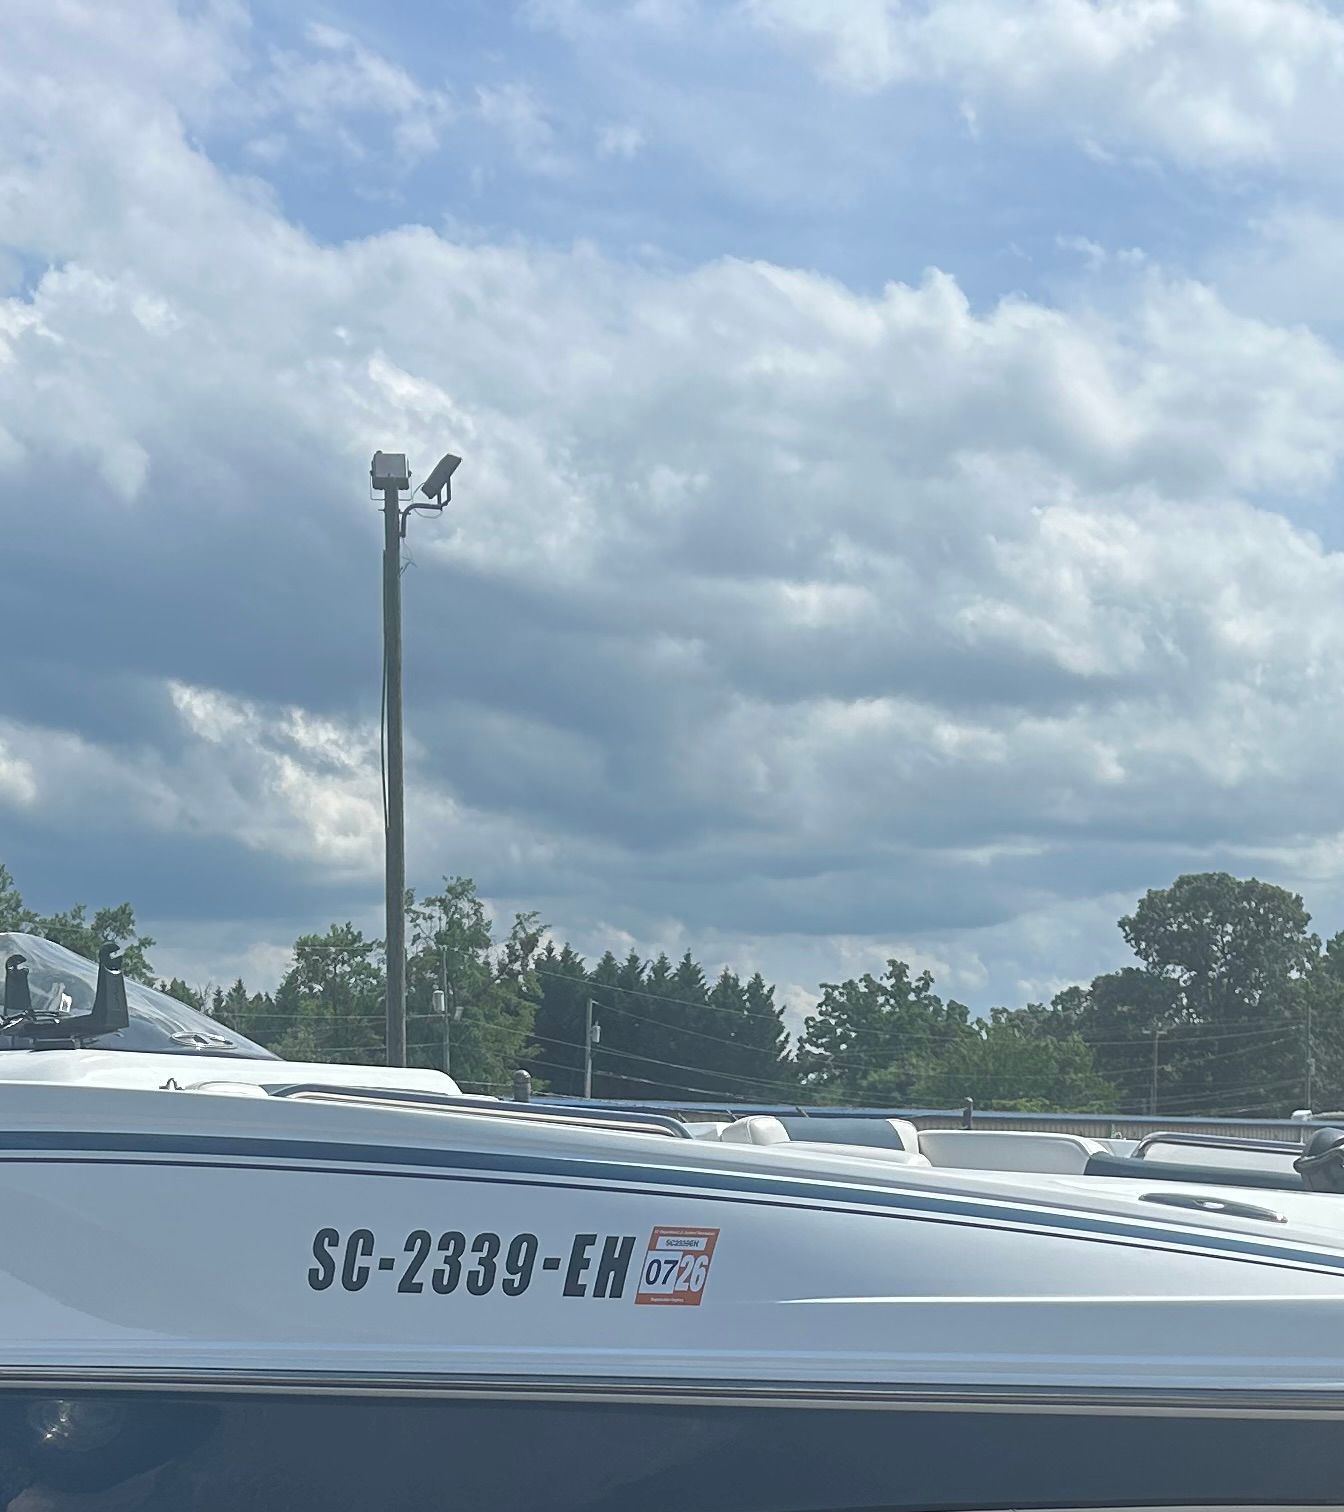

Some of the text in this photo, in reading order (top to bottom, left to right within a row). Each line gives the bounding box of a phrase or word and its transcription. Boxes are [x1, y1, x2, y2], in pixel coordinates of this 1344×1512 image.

[307, 1227, 636, 1299] SC-2339-EH
[645, 1254, 709, 1293] 07 26
